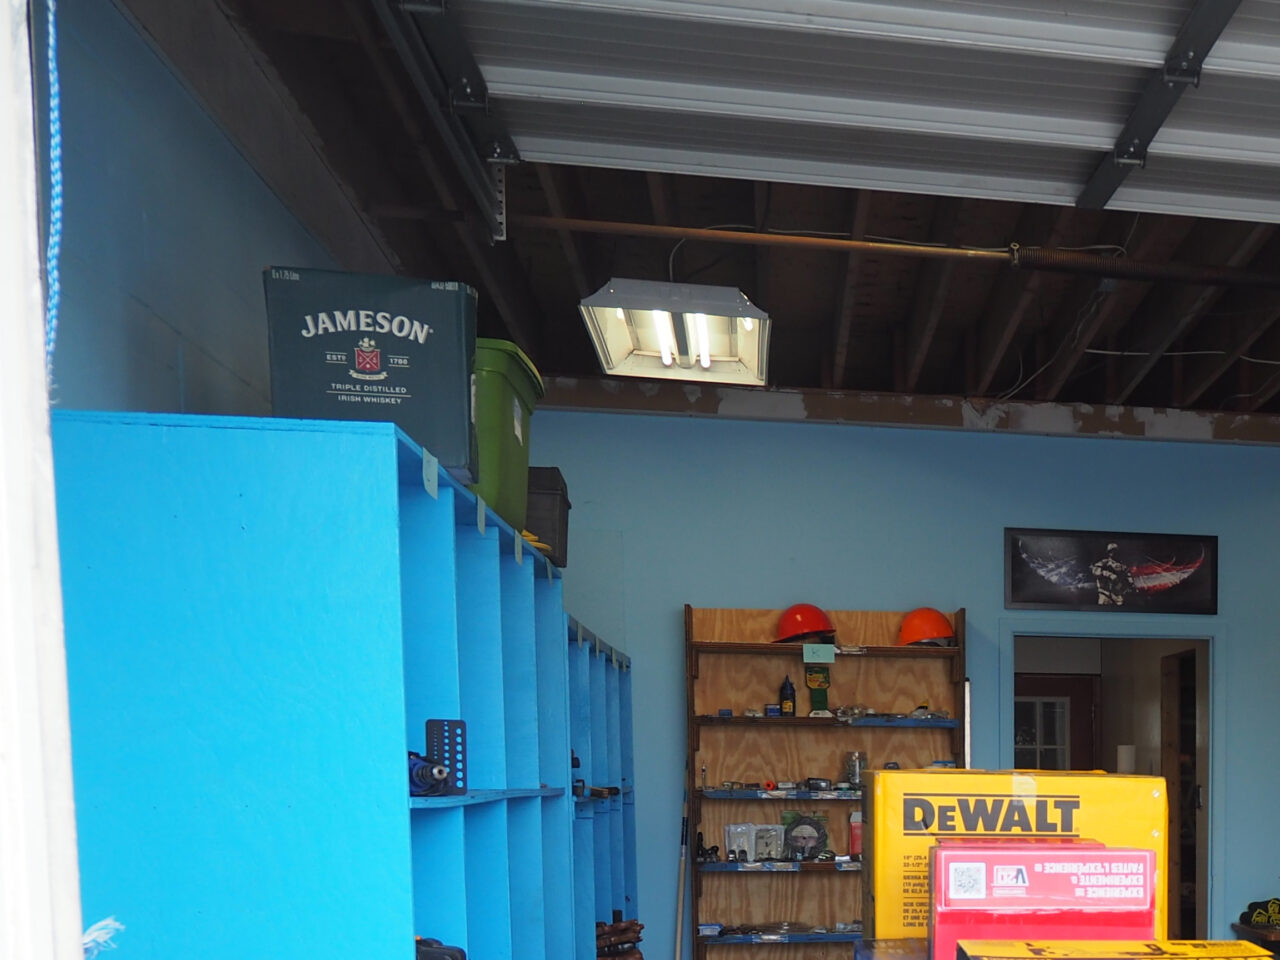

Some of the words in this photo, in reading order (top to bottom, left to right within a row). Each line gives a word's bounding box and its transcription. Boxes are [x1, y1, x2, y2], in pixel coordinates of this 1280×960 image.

[301, 310, 430, 344] JAMESON
[331, 383, 361, 391] TRIPLE
[363, 385, 407, 393] DISTILLED
[363, 396, 402, 404] WHISKEY
[903, 797, 1079, 832] DEWALT
